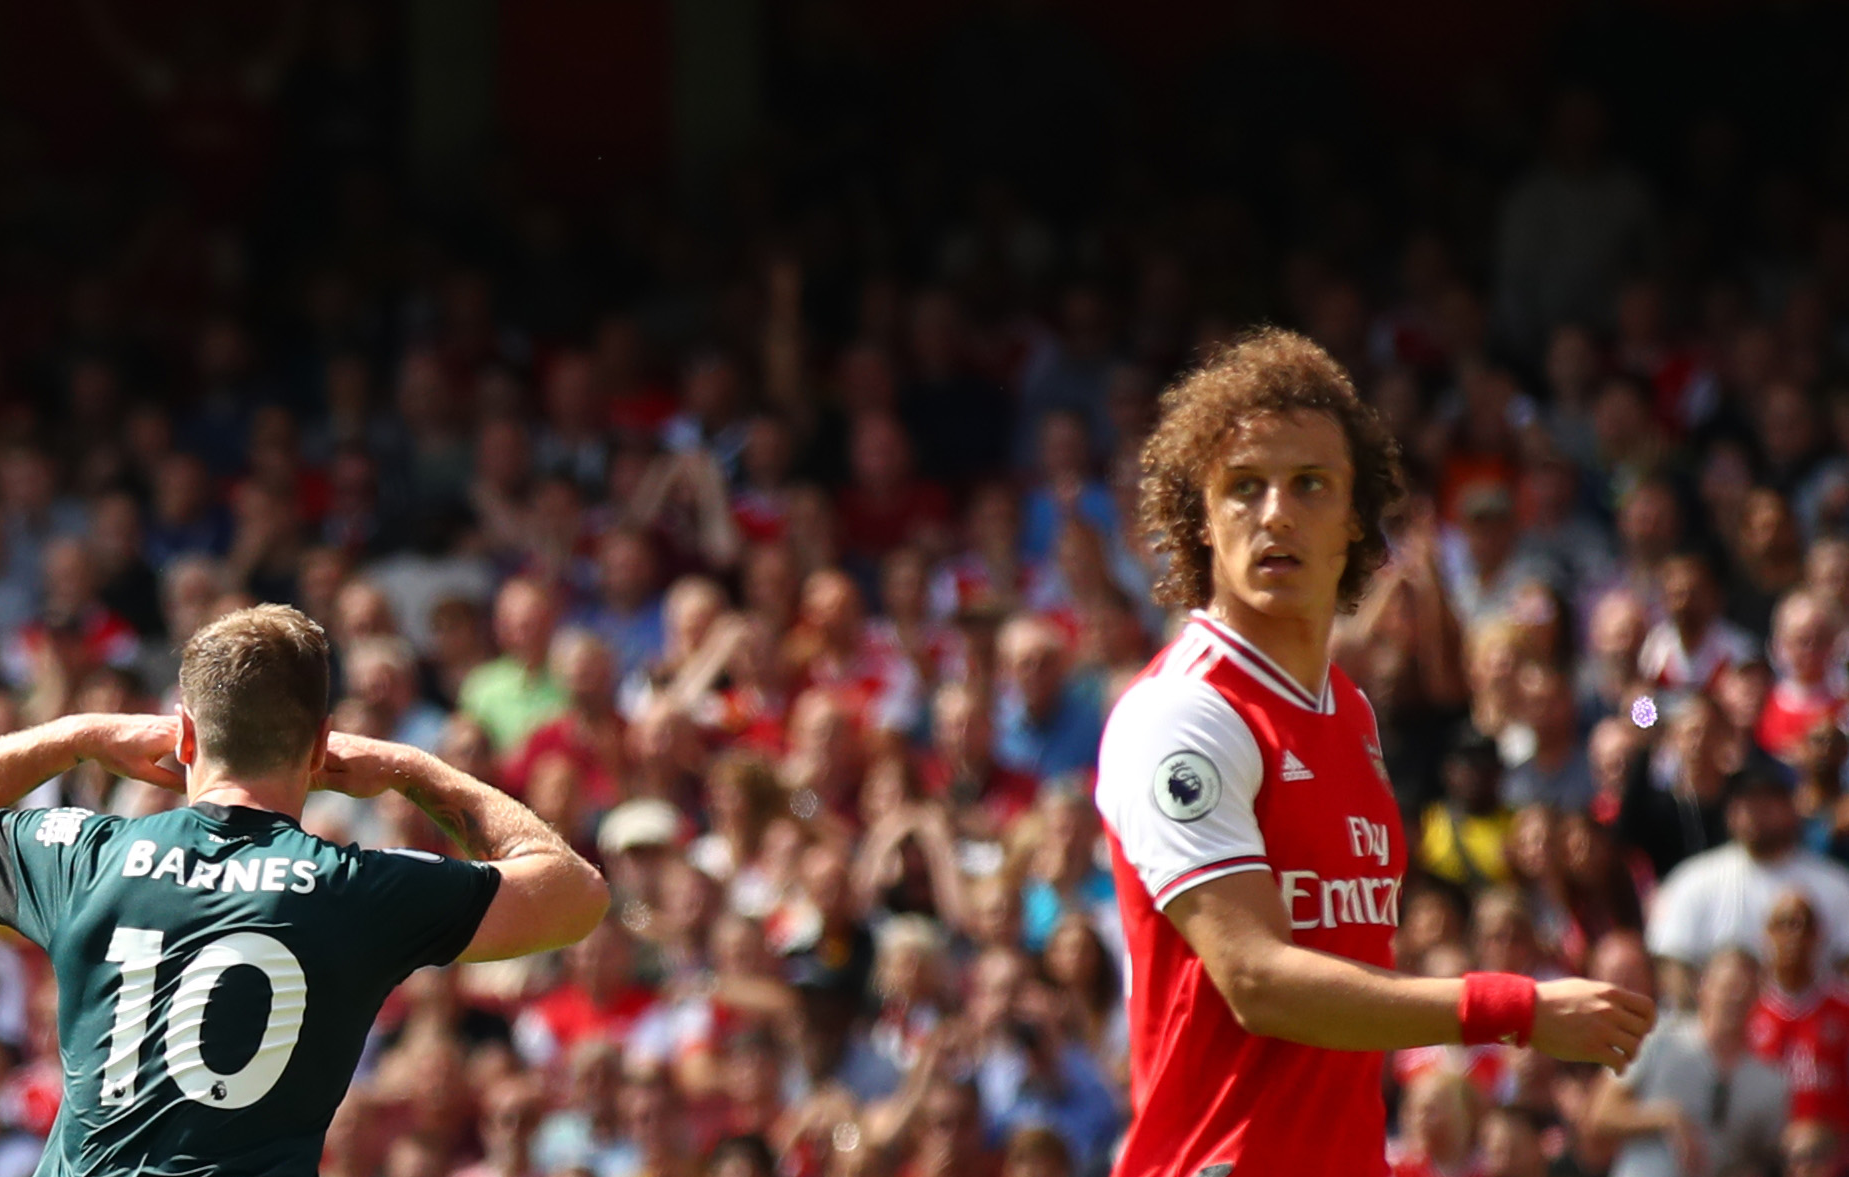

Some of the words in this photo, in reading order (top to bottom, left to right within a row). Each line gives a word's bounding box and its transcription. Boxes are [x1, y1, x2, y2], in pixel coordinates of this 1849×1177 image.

[121, 839, 318, 894] BARNES
[1346, 815, 1389, 866] Fly
[1279, 869, 1402, 929] Emira
[100, 926, 307, 1110] 10
